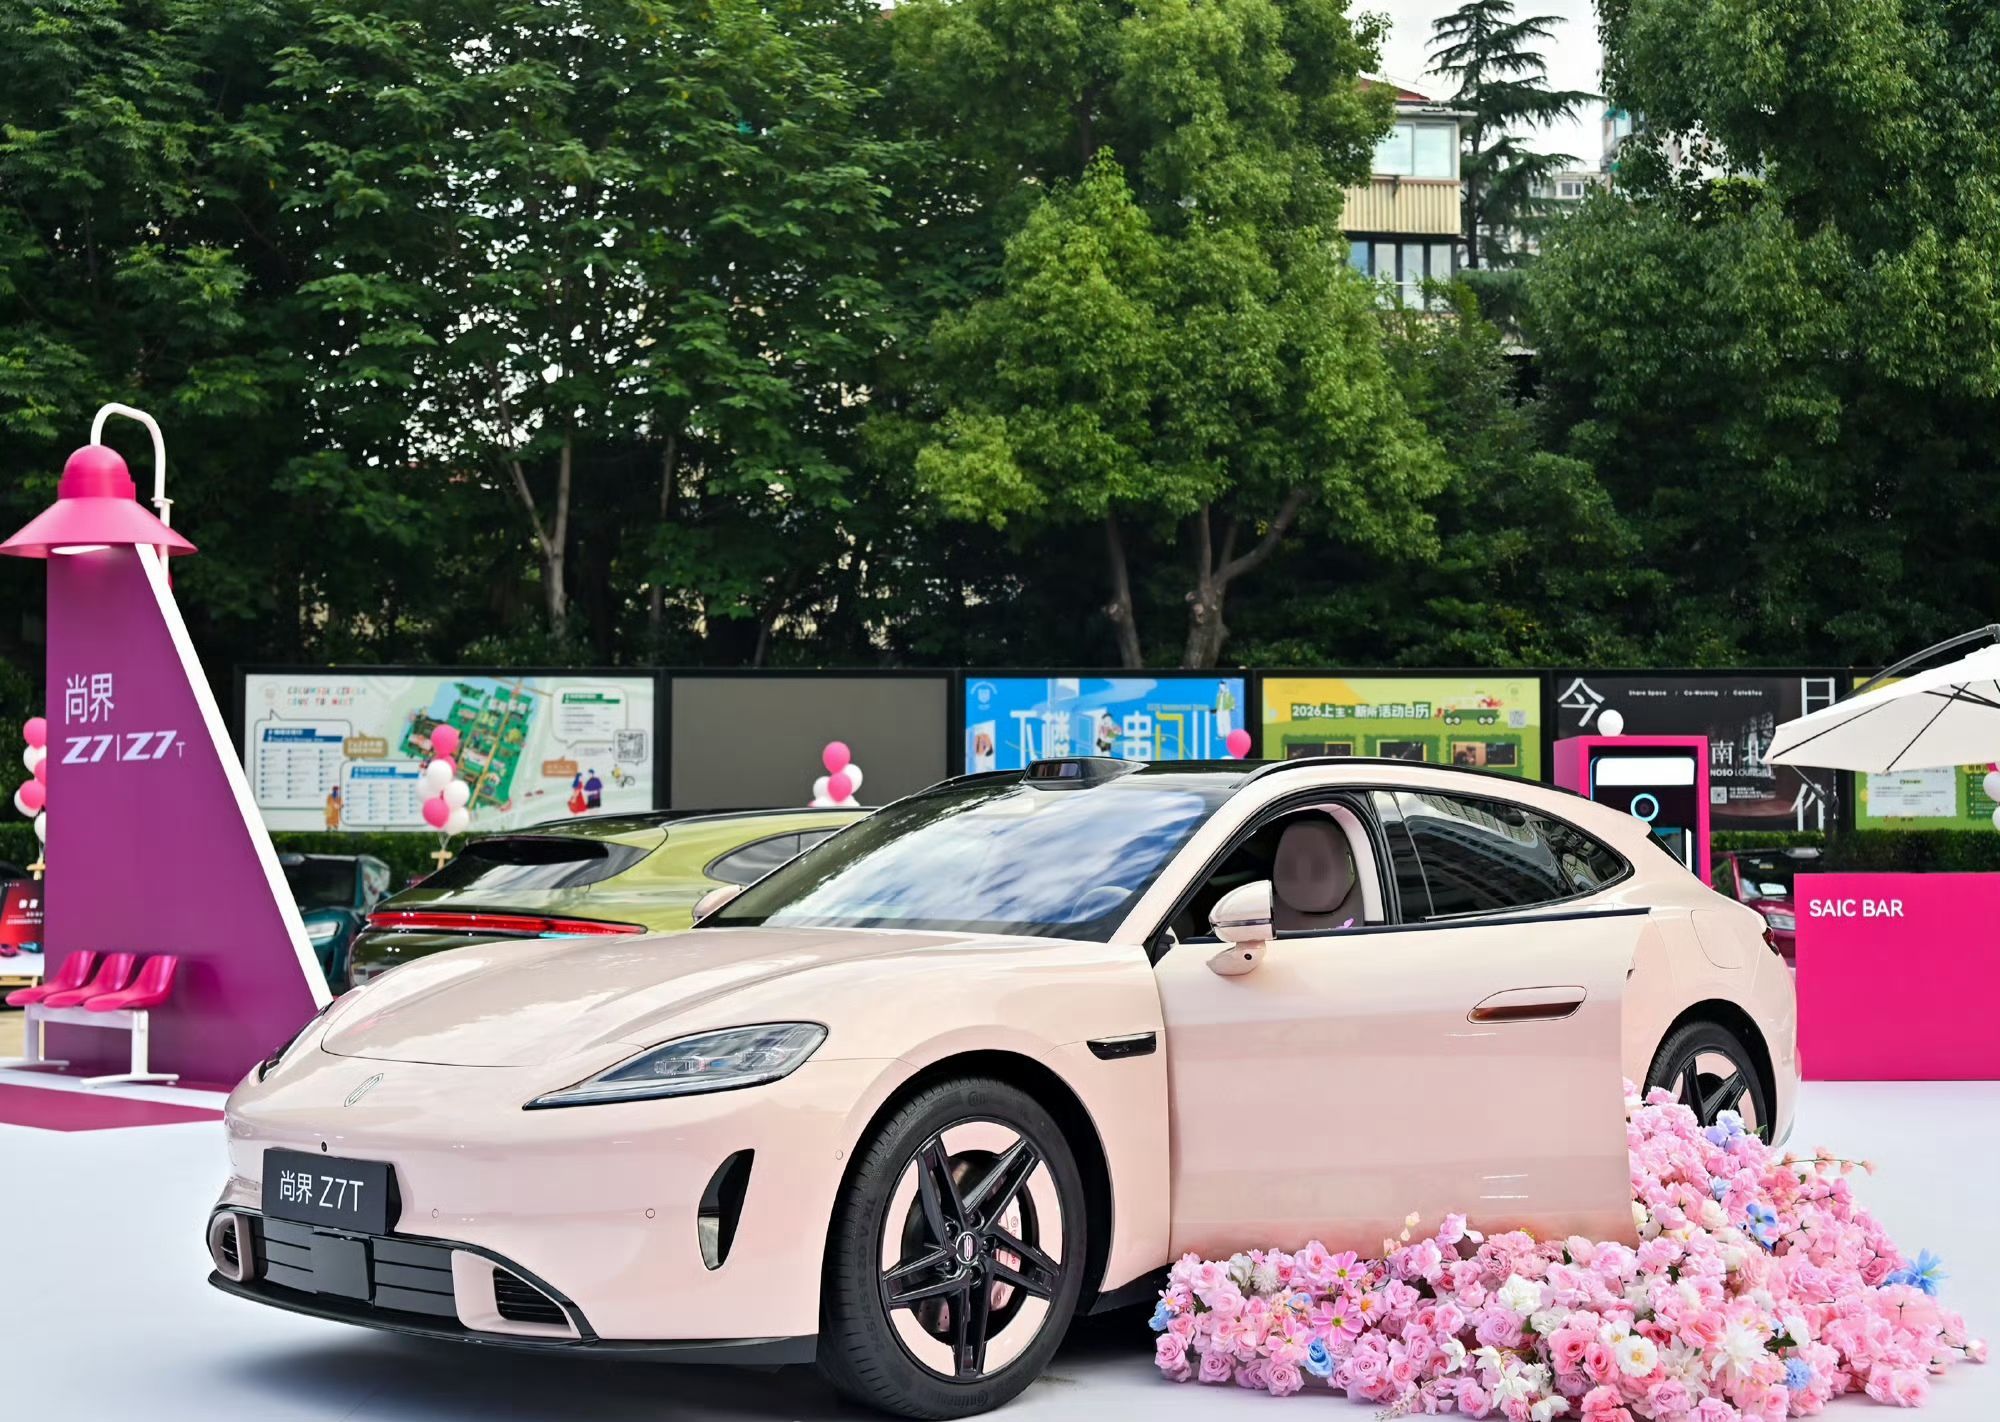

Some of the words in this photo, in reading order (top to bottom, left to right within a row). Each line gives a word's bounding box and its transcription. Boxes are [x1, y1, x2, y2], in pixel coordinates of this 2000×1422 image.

[64, 672, 115, 726] 尚界
[1556, 677, 1606, 728] 今
[1809, 899, 1857, 918] SAIC
[1862, 899, 1904, 917] BAR
[279, 1169, 313, 1206] 尚界
[318, 1175, 364, 1213] Z7T
